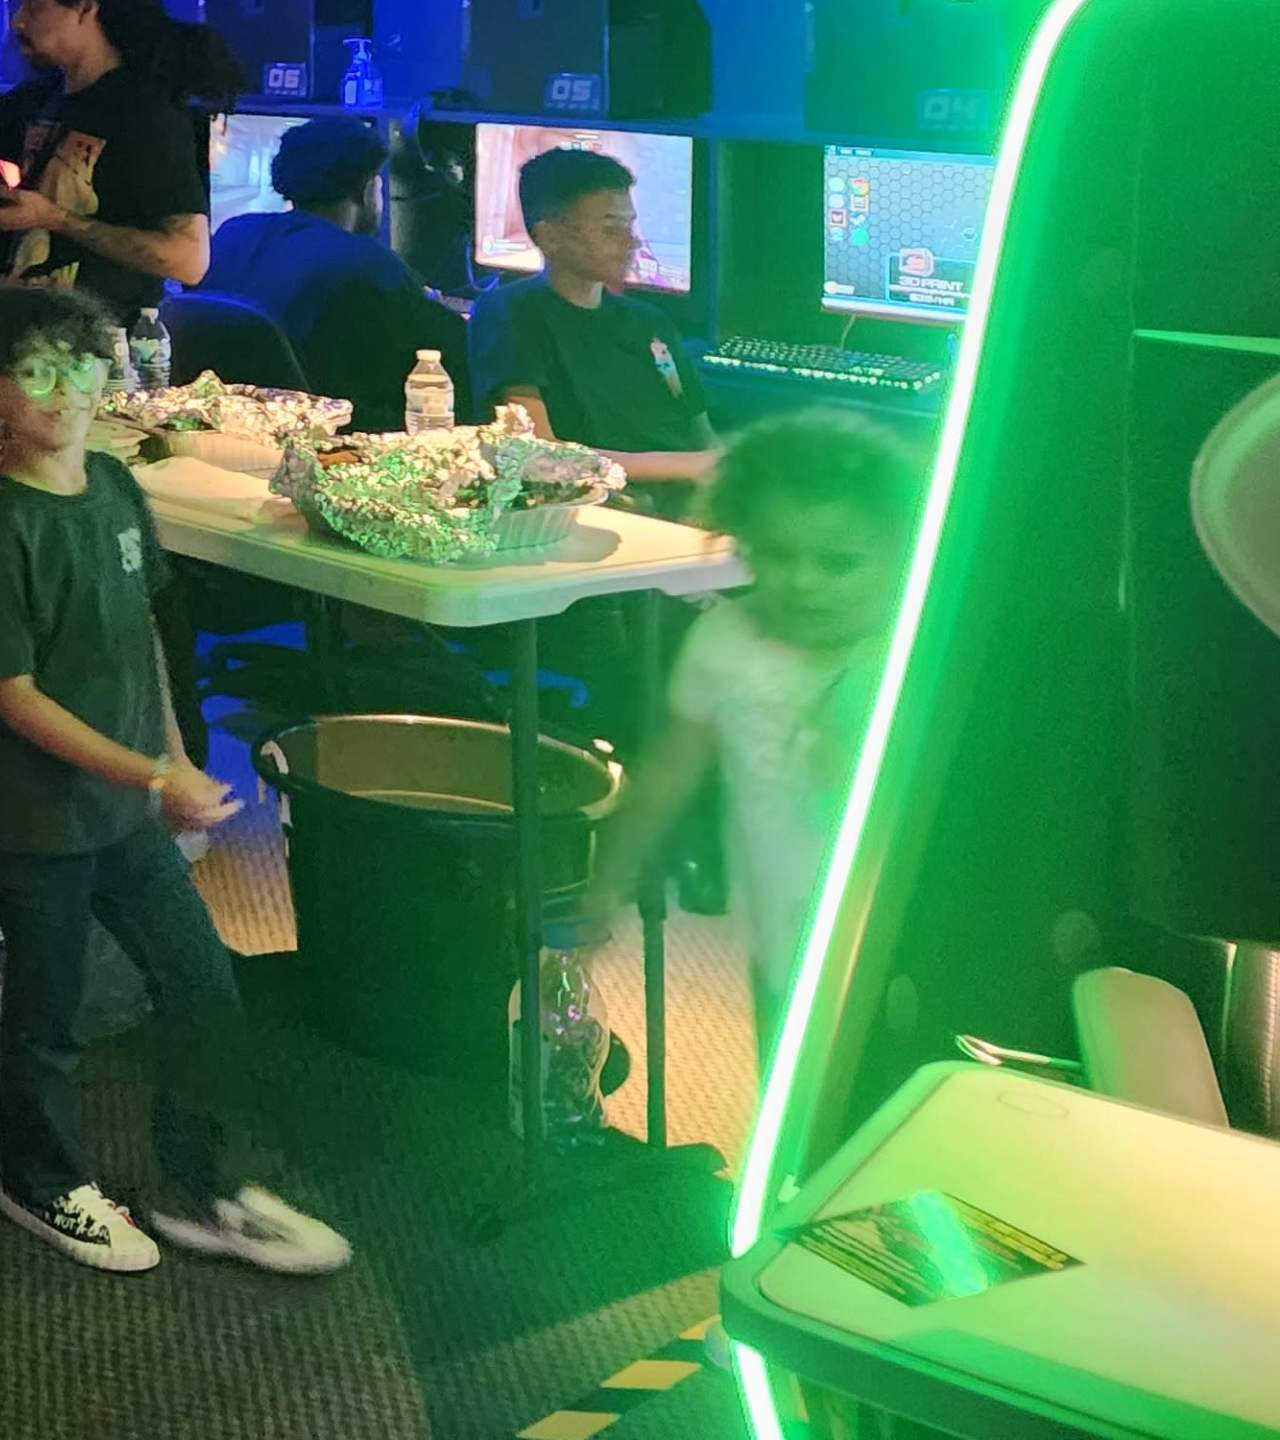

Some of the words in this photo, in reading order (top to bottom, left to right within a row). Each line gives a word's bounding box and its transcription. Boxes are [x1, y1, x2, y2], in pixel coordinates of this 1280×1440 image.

[268, 68, 300, 88] 06
[551, 79, 592, 101] 05
[923, 95, 981, 121] 04
